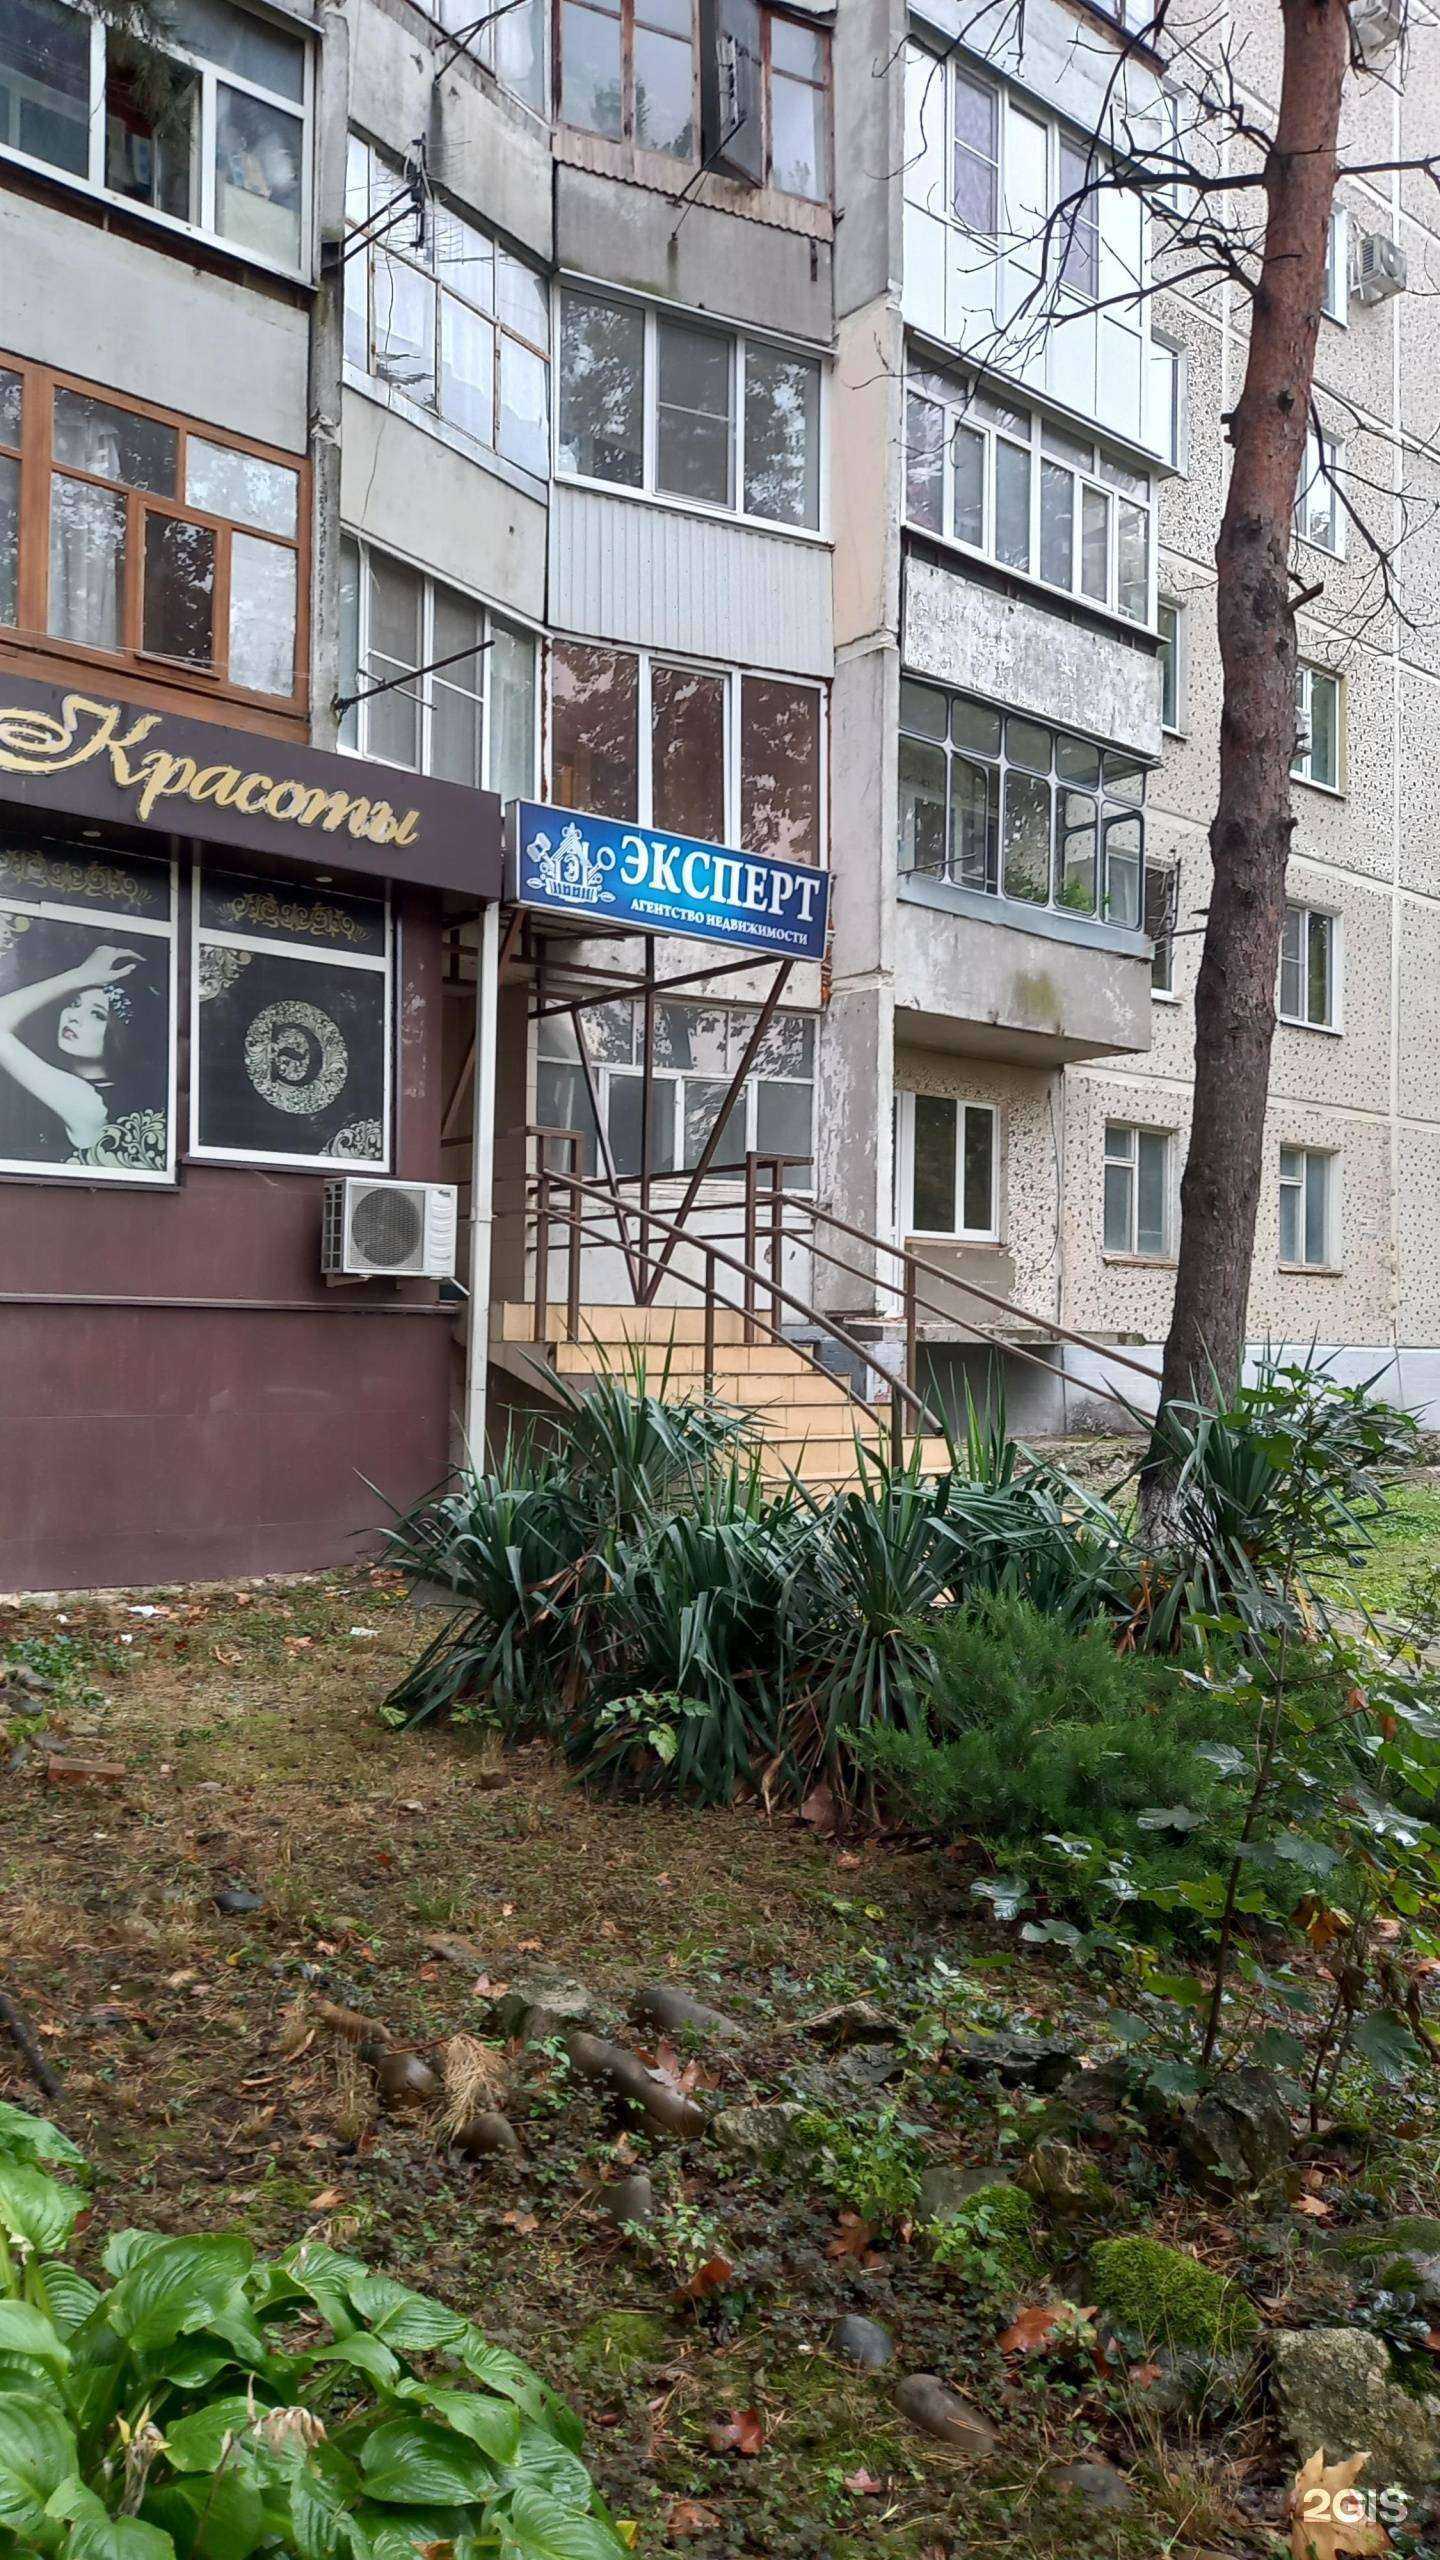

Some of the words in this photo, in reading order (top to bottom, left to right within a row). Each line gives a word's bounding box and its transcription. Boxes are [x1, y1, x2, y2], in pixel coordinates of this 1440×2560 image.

[0, 693, 420, 848] Красоты
[620, 835, 820, 922] ЭКСПЕРТ
[631, 898, 704, 924] АГЕНТСТВО
[706, 913, 808, 945] НЕДВИЖИМОСТИ
